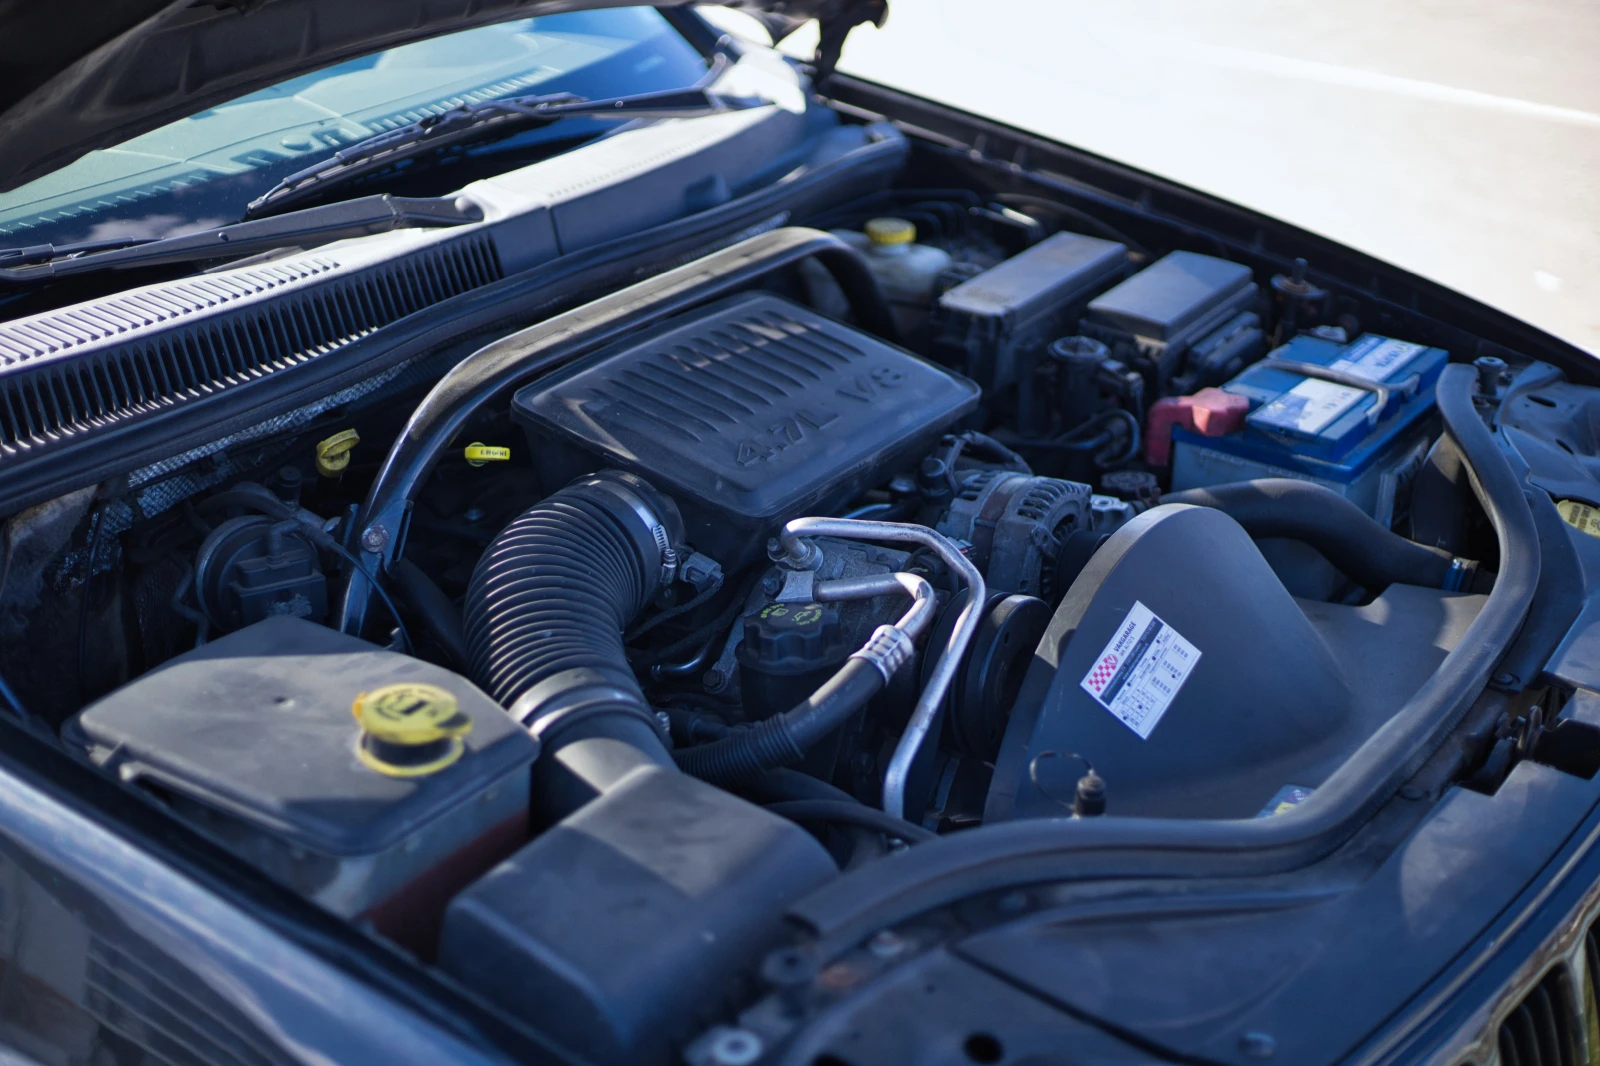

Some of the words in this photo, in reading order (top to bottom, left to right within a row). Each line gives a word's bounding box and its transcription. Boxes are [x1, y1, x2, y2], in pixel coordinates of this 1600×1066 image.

[736, 409, 841, 467] 4.7L
[833, 366, 903, 404] V8
[1113, 621, 1136, 652] VAKGARAGE
